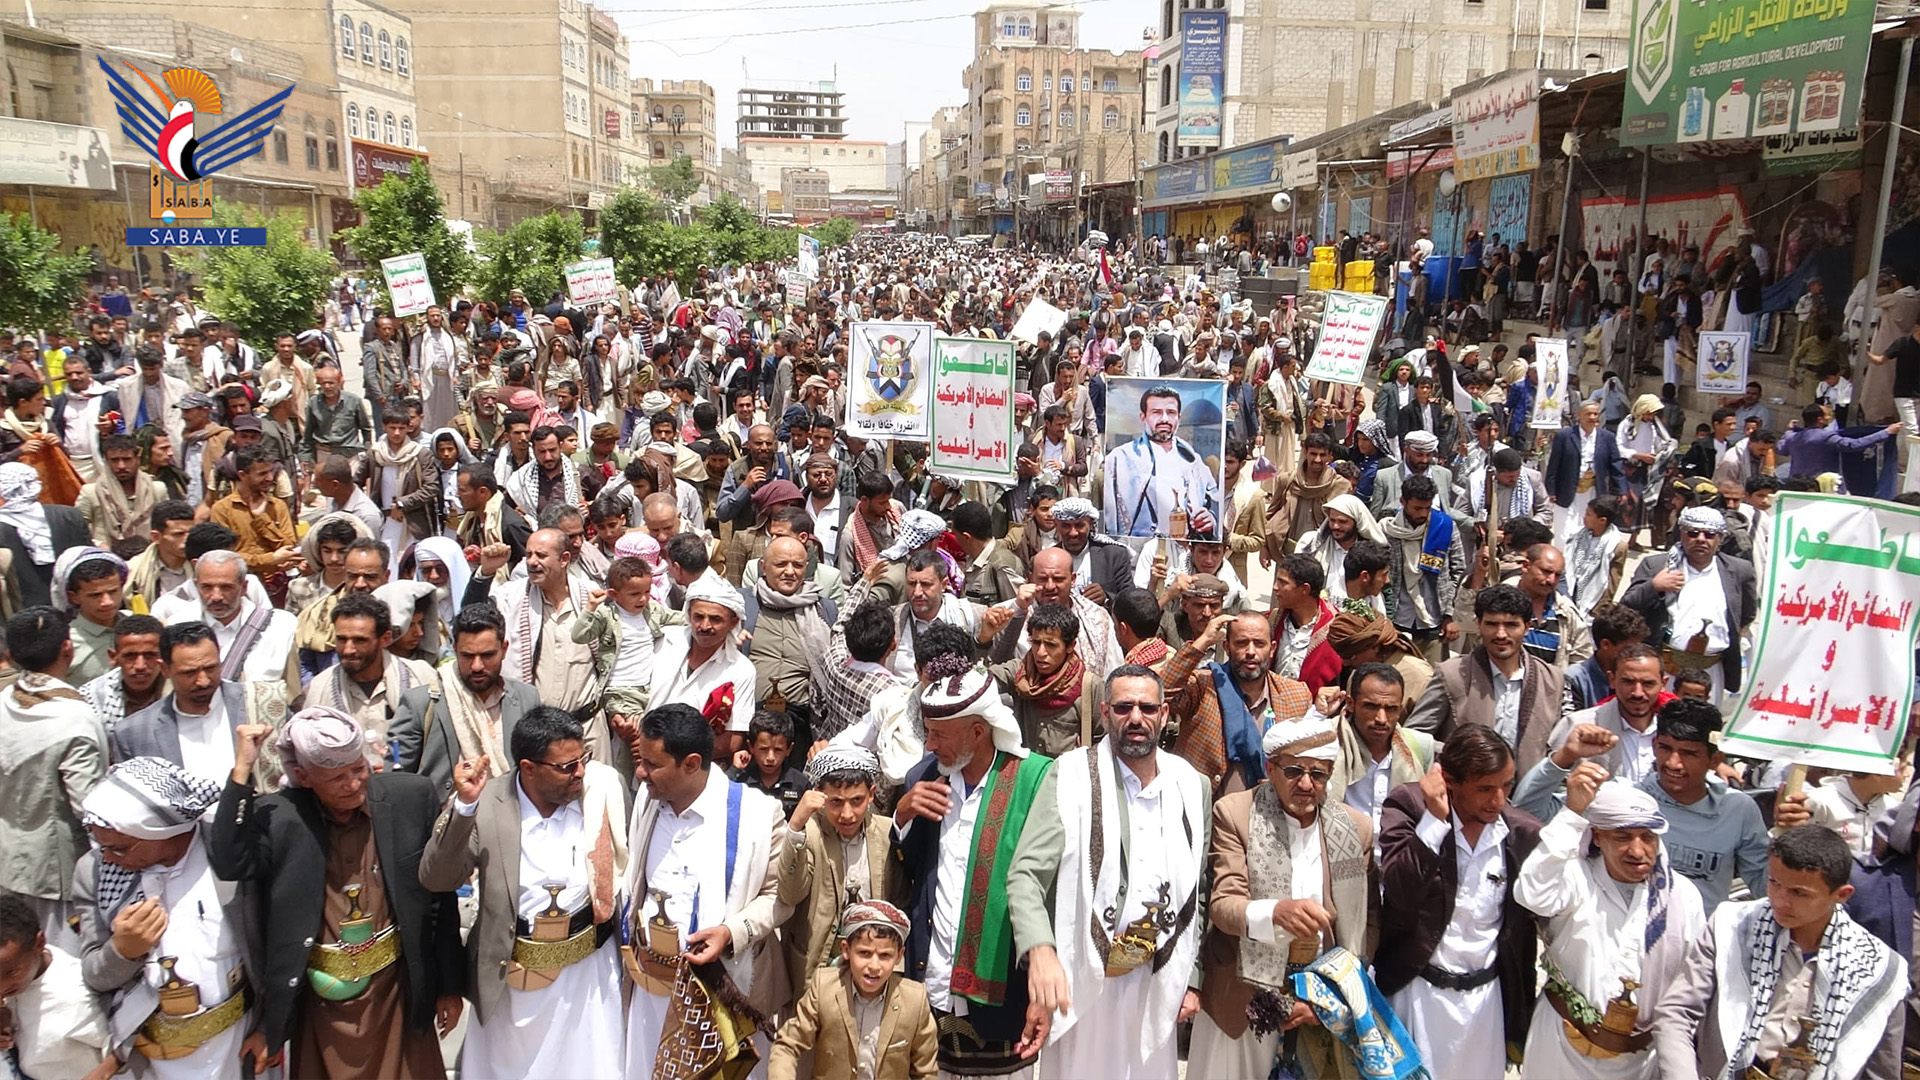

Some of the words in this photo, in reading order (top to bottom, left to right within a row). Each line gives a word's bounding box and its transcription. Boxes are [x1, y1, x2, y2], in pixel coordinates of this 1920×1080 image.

[1693, 6, 1745, 55] الزراعي
[1689, 61, 1719, 77] AL-ZAQRI
[1719, 58, 1731, 72] FOR
[1731, 47, 1785, 70] AGRICULTURAL
[1785, 36, 1845, 60] DEVELOPMENT
[1359, 304, 1381, 317] الله
[938, 349, 1009, 377] قاطعوا
[936, 382, 975, 407] الأمريكية
[975, 386, 1007, 410] البضائع
[968, 412, 974, 429] و
[936, 435, 1007, 462] الإسرائيلية
[1785, 516, 1920, 576] اطعوا
[1776, 581, 1849, 626] الأمريكية
[1845, 590, 1912, 638] البضائع
[1822, 640, 1837, 672] و
[1748, 682, 1898, 734] الإسرائيلية
[1669, 841, 1725, 876] LIBU
